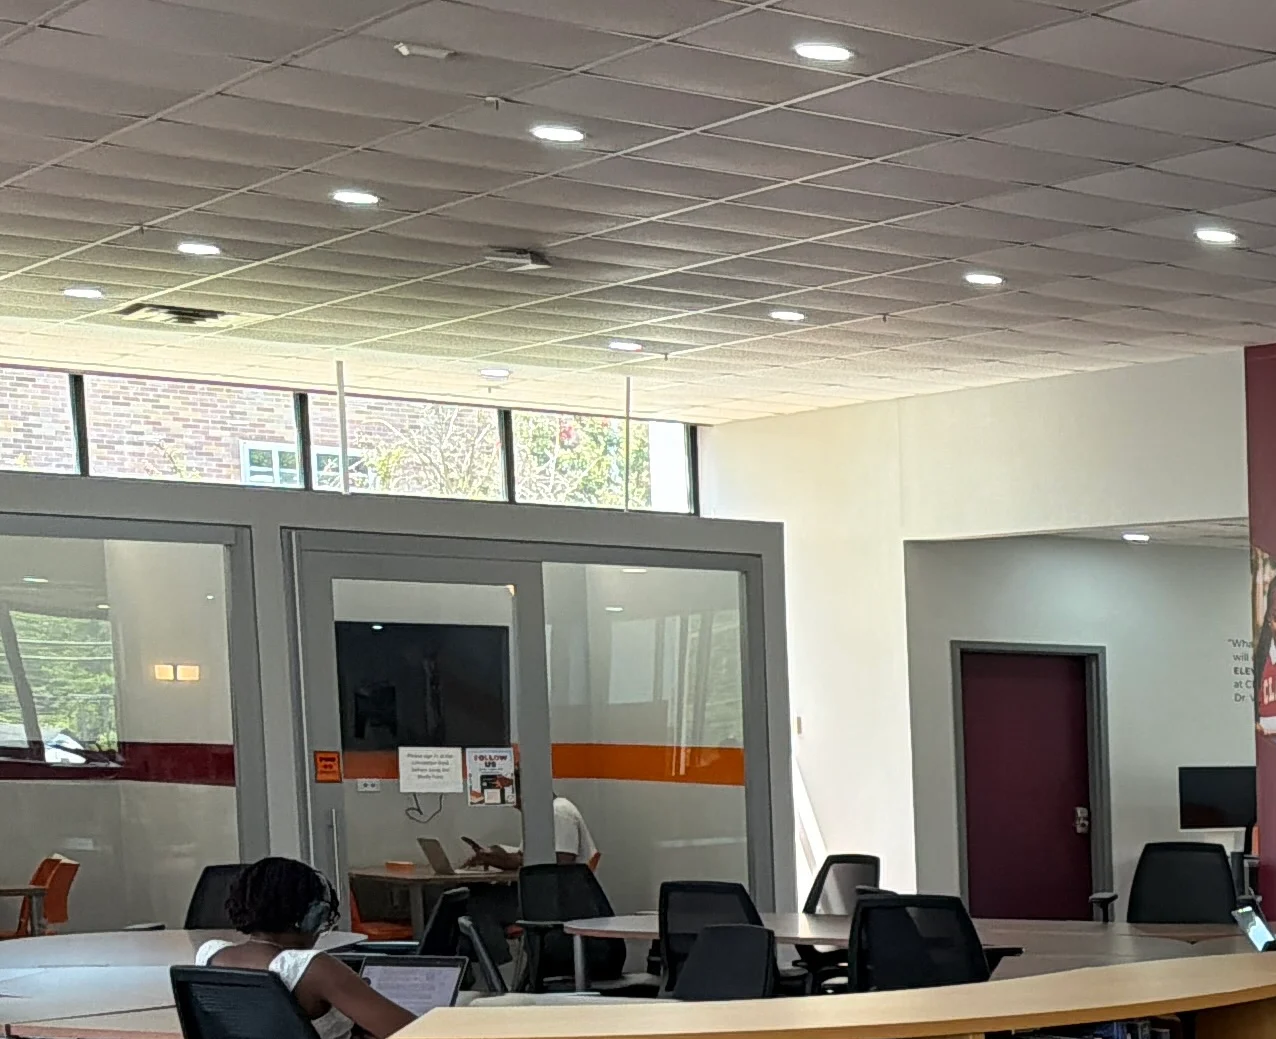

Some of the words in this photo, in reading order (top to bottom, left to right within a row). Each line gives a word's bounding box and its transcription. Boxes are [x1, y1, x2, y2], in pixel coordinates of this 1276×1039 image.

[1233, 653, 1249, 661] will
[1233, 681, 1243, 689] at
[474, 754, 508, 762] FOLLOW
